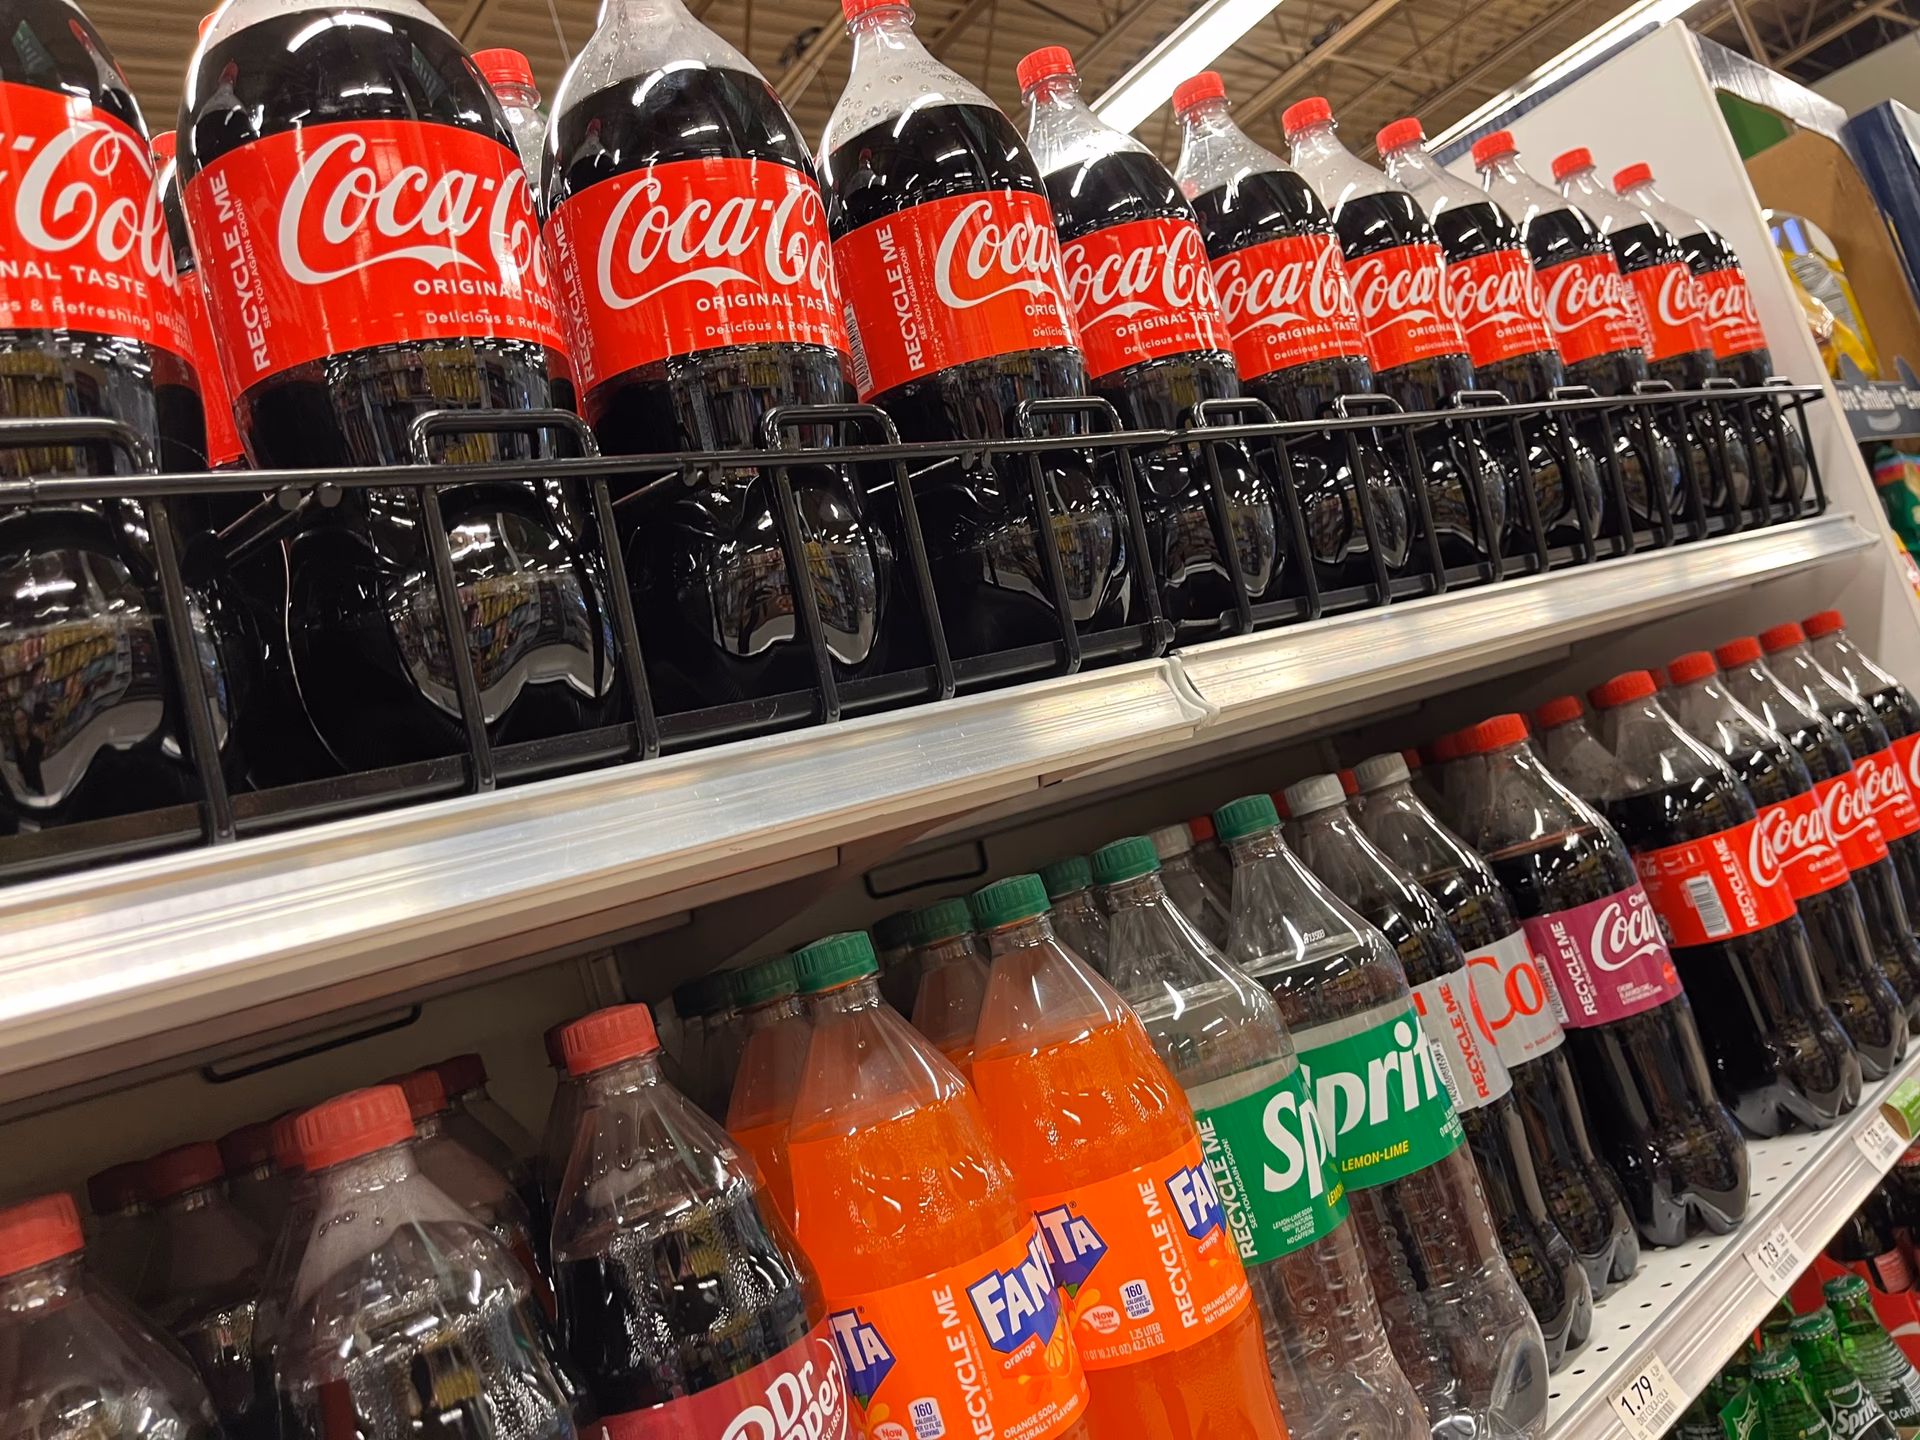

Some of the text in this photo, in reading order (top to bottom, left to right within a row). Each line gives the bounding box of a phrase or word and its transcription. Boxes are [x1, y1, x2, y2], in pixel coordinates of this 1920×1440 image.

[0, 119, 181, 297] -Cola
[209, 169, 271, 372] RECYCLE ME
[235, 199, 271, 329] SEE YOU AGAIN SOON!
[69, 264, 148, 299] TASTE
[413, 279, 521, 300] ORIGINAL
[553, 217, 595, 384] RECYCLE ME
[696, 293, 836, 316] ORIGINAL TASTE
[875, 223, 926, 372] RECYCLE ME
[1025, 303, 1058, 316] ORIG
[30, 299, 43, 312] &
[53, 296, 151, 331] Refreshing
[426, 308, 501, 324] Delicious
[506, 314, 514, 325] &
[1115, 313, 1187, 337] ORIGINAL
[705, 320, 772, 336] Delicious
[776, 321, 785, 330] &
[1267, 323, 1331, 345] ORIGINAL
[1407, 322, 1456, 338] ORIGINAL
[1496, 322, 1543, 338] ORIGINAL
[1124, 336, 1173, 355] Delicious
[1175, 333, 1182, 343] &
[1274, 345, 1318, 360] Delicious
[1712, 837, 1732, 862] ME
[1722, 861, 1759, 927] RECYCLE
[1550, 921, 1569, 947] ME
[1560, 946, 1598, 1016] RECYCLE
[1438, 982, 1457, 1014] ME
[1450, 1014, 1490, 1099] RECYCLE
[1300, 1016, 1446, 1158] prit
[1341, 1139, 1409, 1172] LEMON-LIME
[1196, 1117, 1258, 1259] RECYCLE ME
[1222, 1138, 1258, 1229] SEE YOU AGAIN SOON!
[1137, 1178, 1162, 1218] ME
[1272, 1211, 1302, 1230] LEMON-LIME
[1286, 1236, 1295, 1245] NO
[1757, 1241, 1779, 1269] 1.79
[1151, 1218, 1198, 1328] RECYCLE
[1125, 1283, 1143, 1298] 160
[1201, 1293, 1227, 1315] ORANGE
[932, 1284, 960, 1329] ME
[1092, 1310, 1115, 1321] Now
[1204, 1297, 1236, 1325] NATURALLY
[1128, 1322, 1161, 1340] 1.25 LITER
[1132, 1338, 1147, 1351] 42.2
[1146, 1336, 1155, 1347] FL
[1155, 1333, 1165, 1345] OZ
[1003, 1340, 1036, 1370] orange
[946, 1330, 995, 1440] RECYCLE
[1621, 1375, 1653, 1416] 1.79
[765, 1360, 814, 1439] Dr
[914, 1402, 933, 1418] 160
[1003, 1401, 1057, 1439] ORANGE SODA
[1011, 1417, 1052, 1440] ATURALLY
[1889, 1410, 1901, 1421] CA
[881, 1428, 903, 1438] Now
